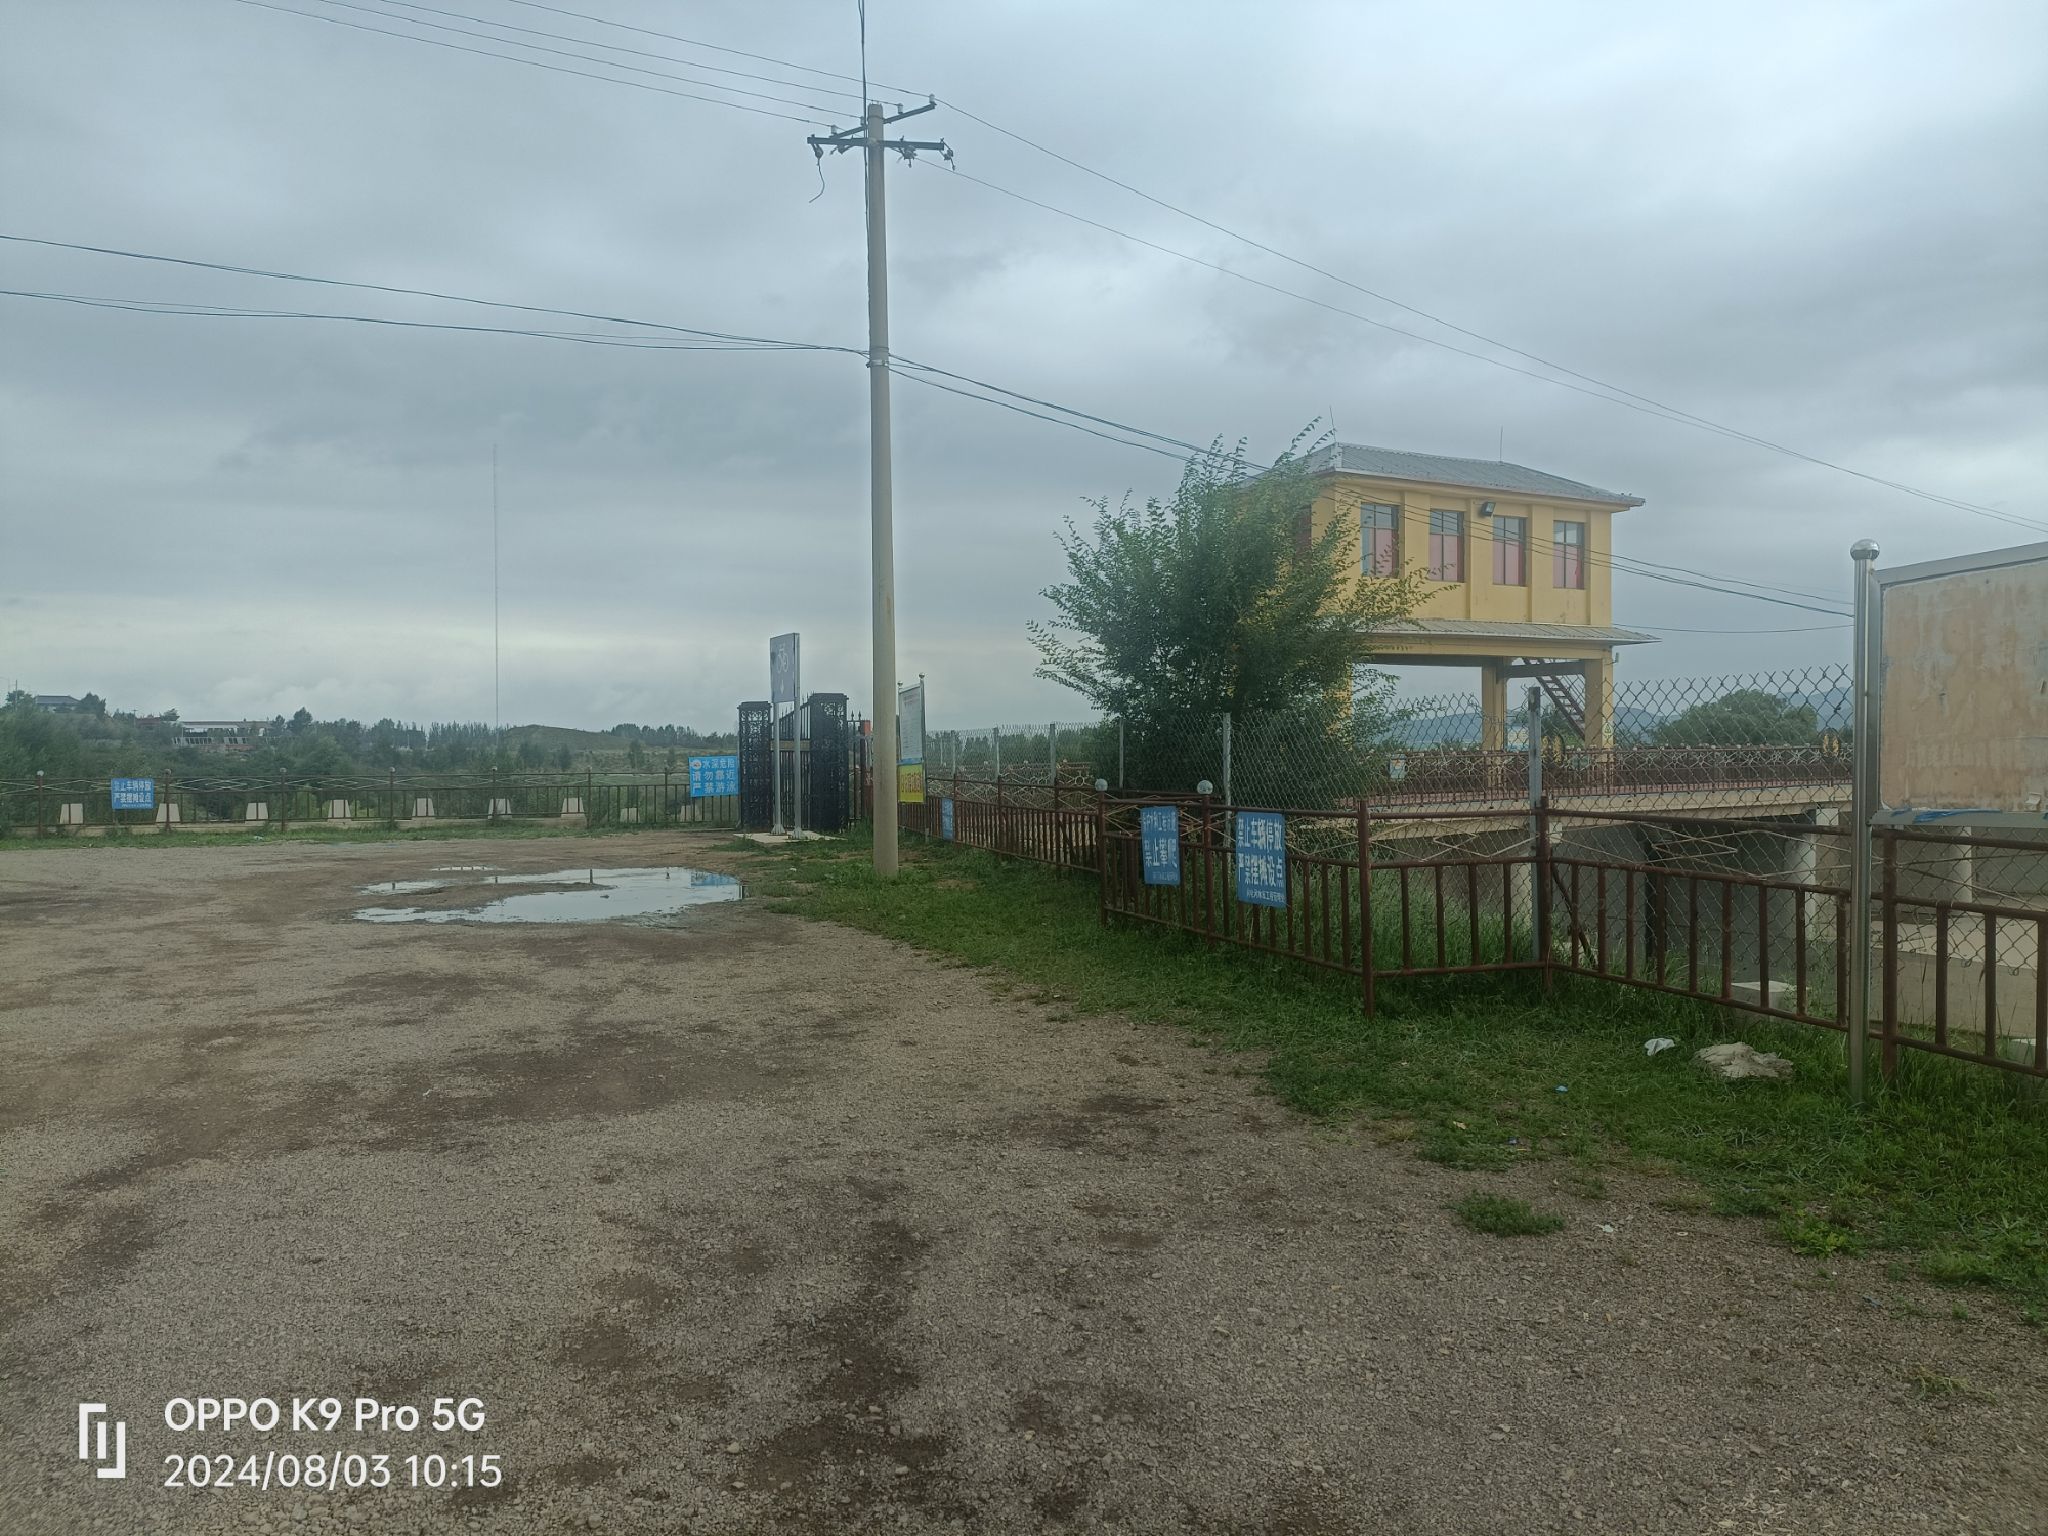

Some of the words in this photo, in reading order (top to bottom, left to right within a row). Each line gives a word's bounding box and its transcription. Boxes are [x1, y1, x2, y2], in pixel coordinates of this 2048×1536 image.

[1237, 817, 1283, 852] 禁止车辆停放
[1237, 853, 1285, 887] 严禁摆摊设点
